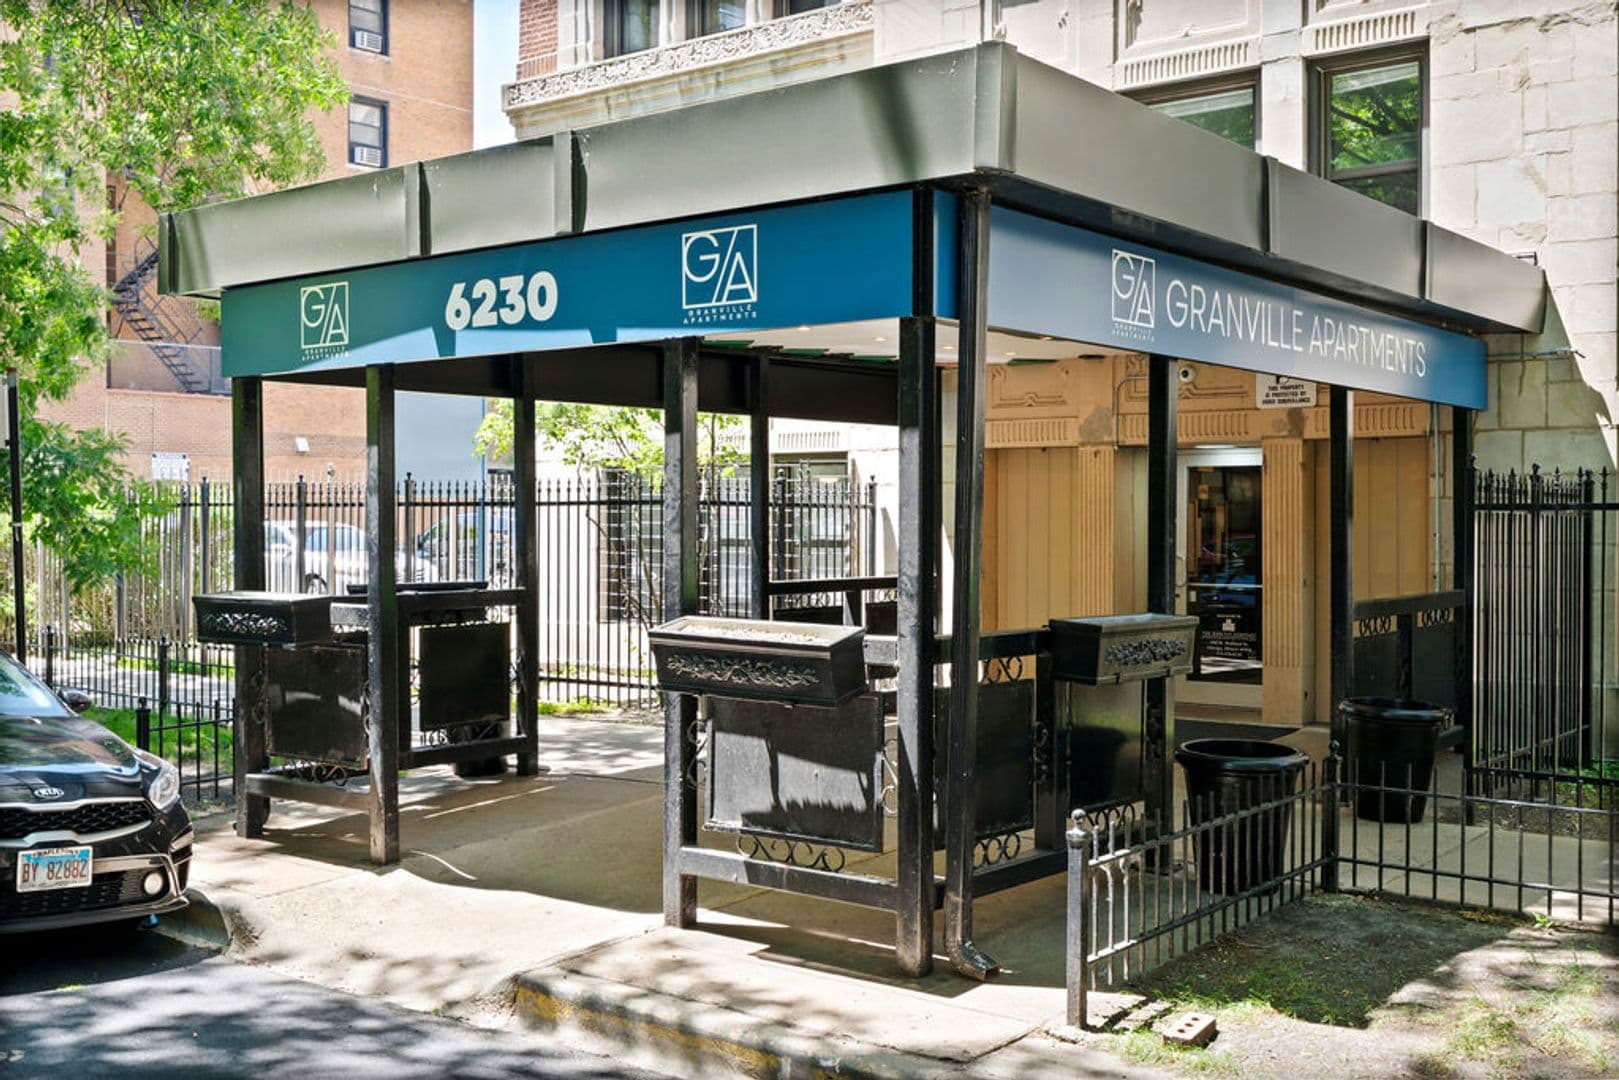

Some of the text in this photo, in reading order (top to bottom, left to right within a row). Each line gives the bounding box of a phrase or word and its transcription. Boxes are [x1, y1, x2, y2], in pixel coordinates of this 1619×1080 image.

[445, 270, 559, 331] 6230
[687, 303, 752, 317] GRANVILLE
[682, 311, 757, 325] APARTMENTS
[1166, 279, 1427, 378] GRANVILLE APARTMENTS
[22, 858, 88, 883] BY 82882
